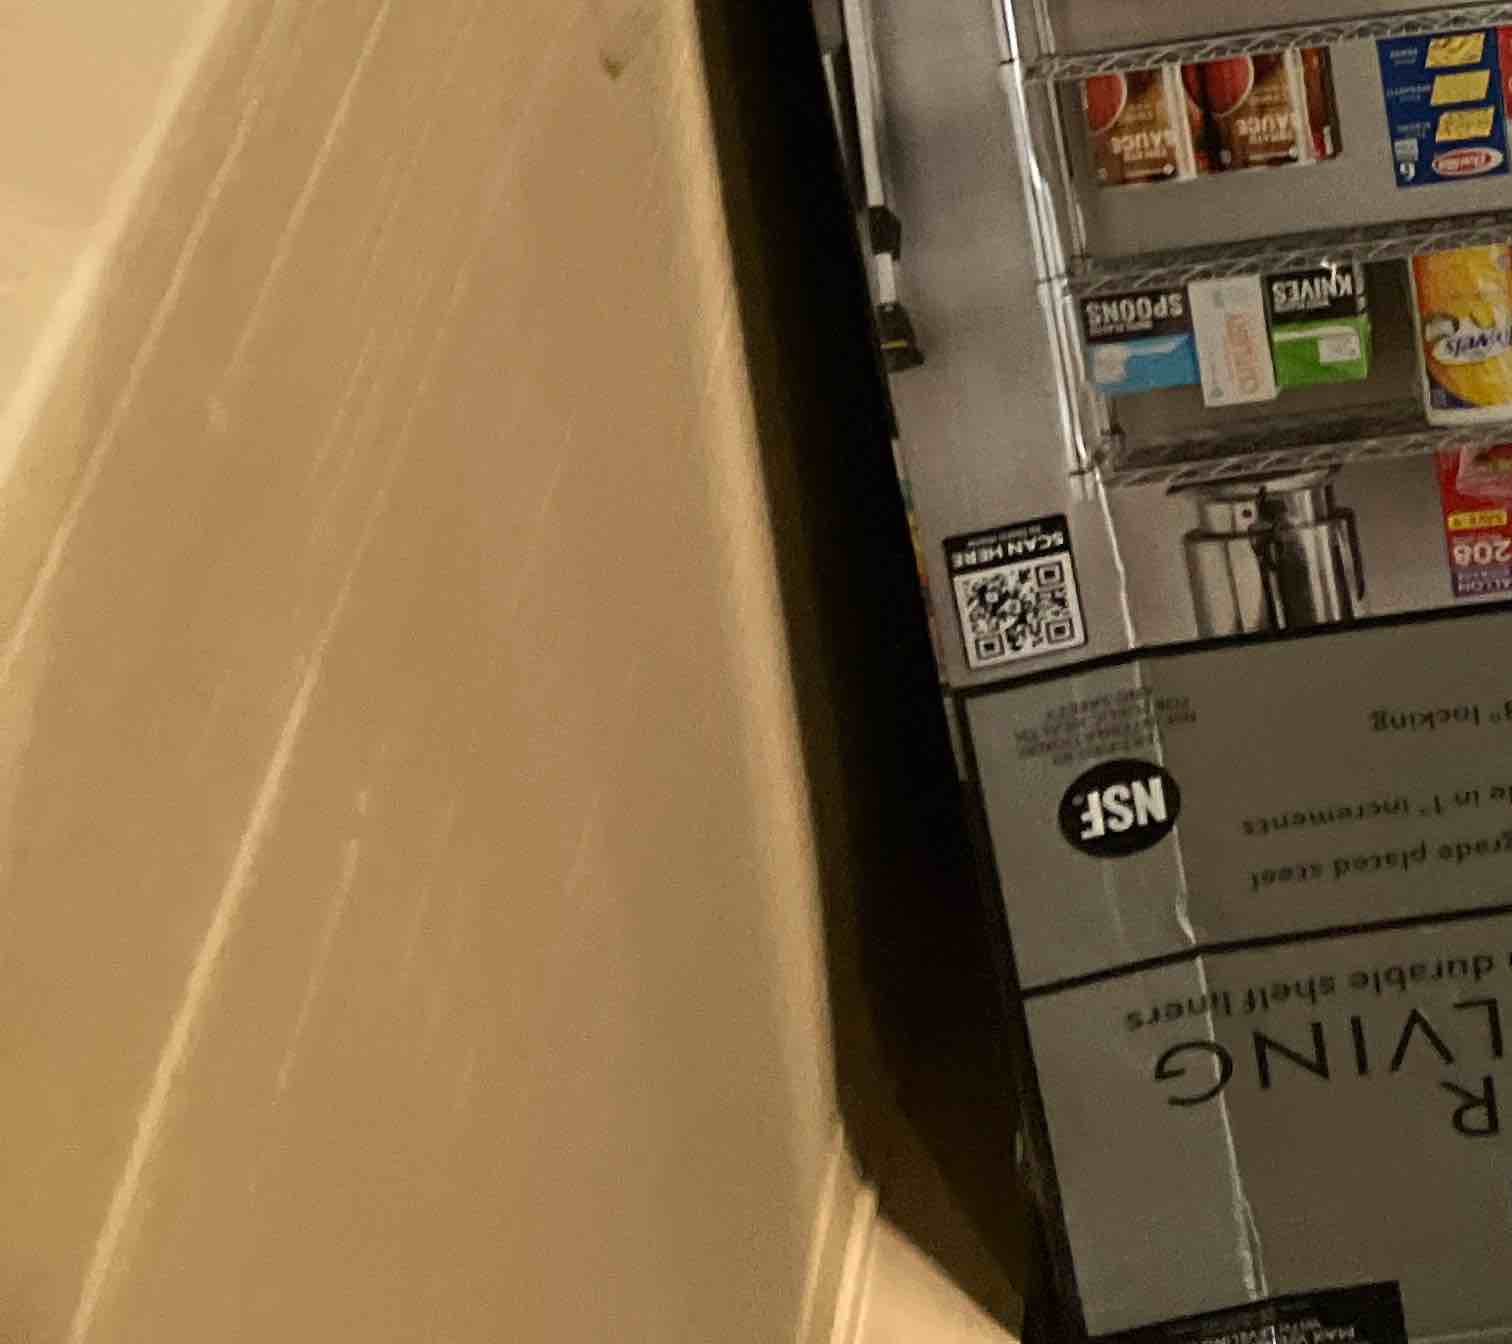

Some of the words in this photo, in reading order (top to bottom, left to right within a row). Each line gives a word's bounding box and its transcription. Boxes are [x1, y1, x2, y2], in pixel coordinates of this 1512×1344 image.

[1270, 273, 1354, 306] KNIVES
[1085, 293, 1184, 322] SPOONS
[954, 544, 1003, 568] HERE
[1007, 532, 1064, 556] SCAN
[1453, 538, 1512, 566] 208
[1371, 706, 1480, 731] locking
[1081, 777, 1167, 839] NSF
[1455, 790, 1480, 806] in
[1243, 799, 1409, 835] increments
[1251, 864, 1320, 891] steel
[1333, 847, 1427, 879] plated
[1351, 956, 1494, 995] durable
[1127, 988, 1234, 1032] liners
[1242, 976, 1335, 1016] shelf
